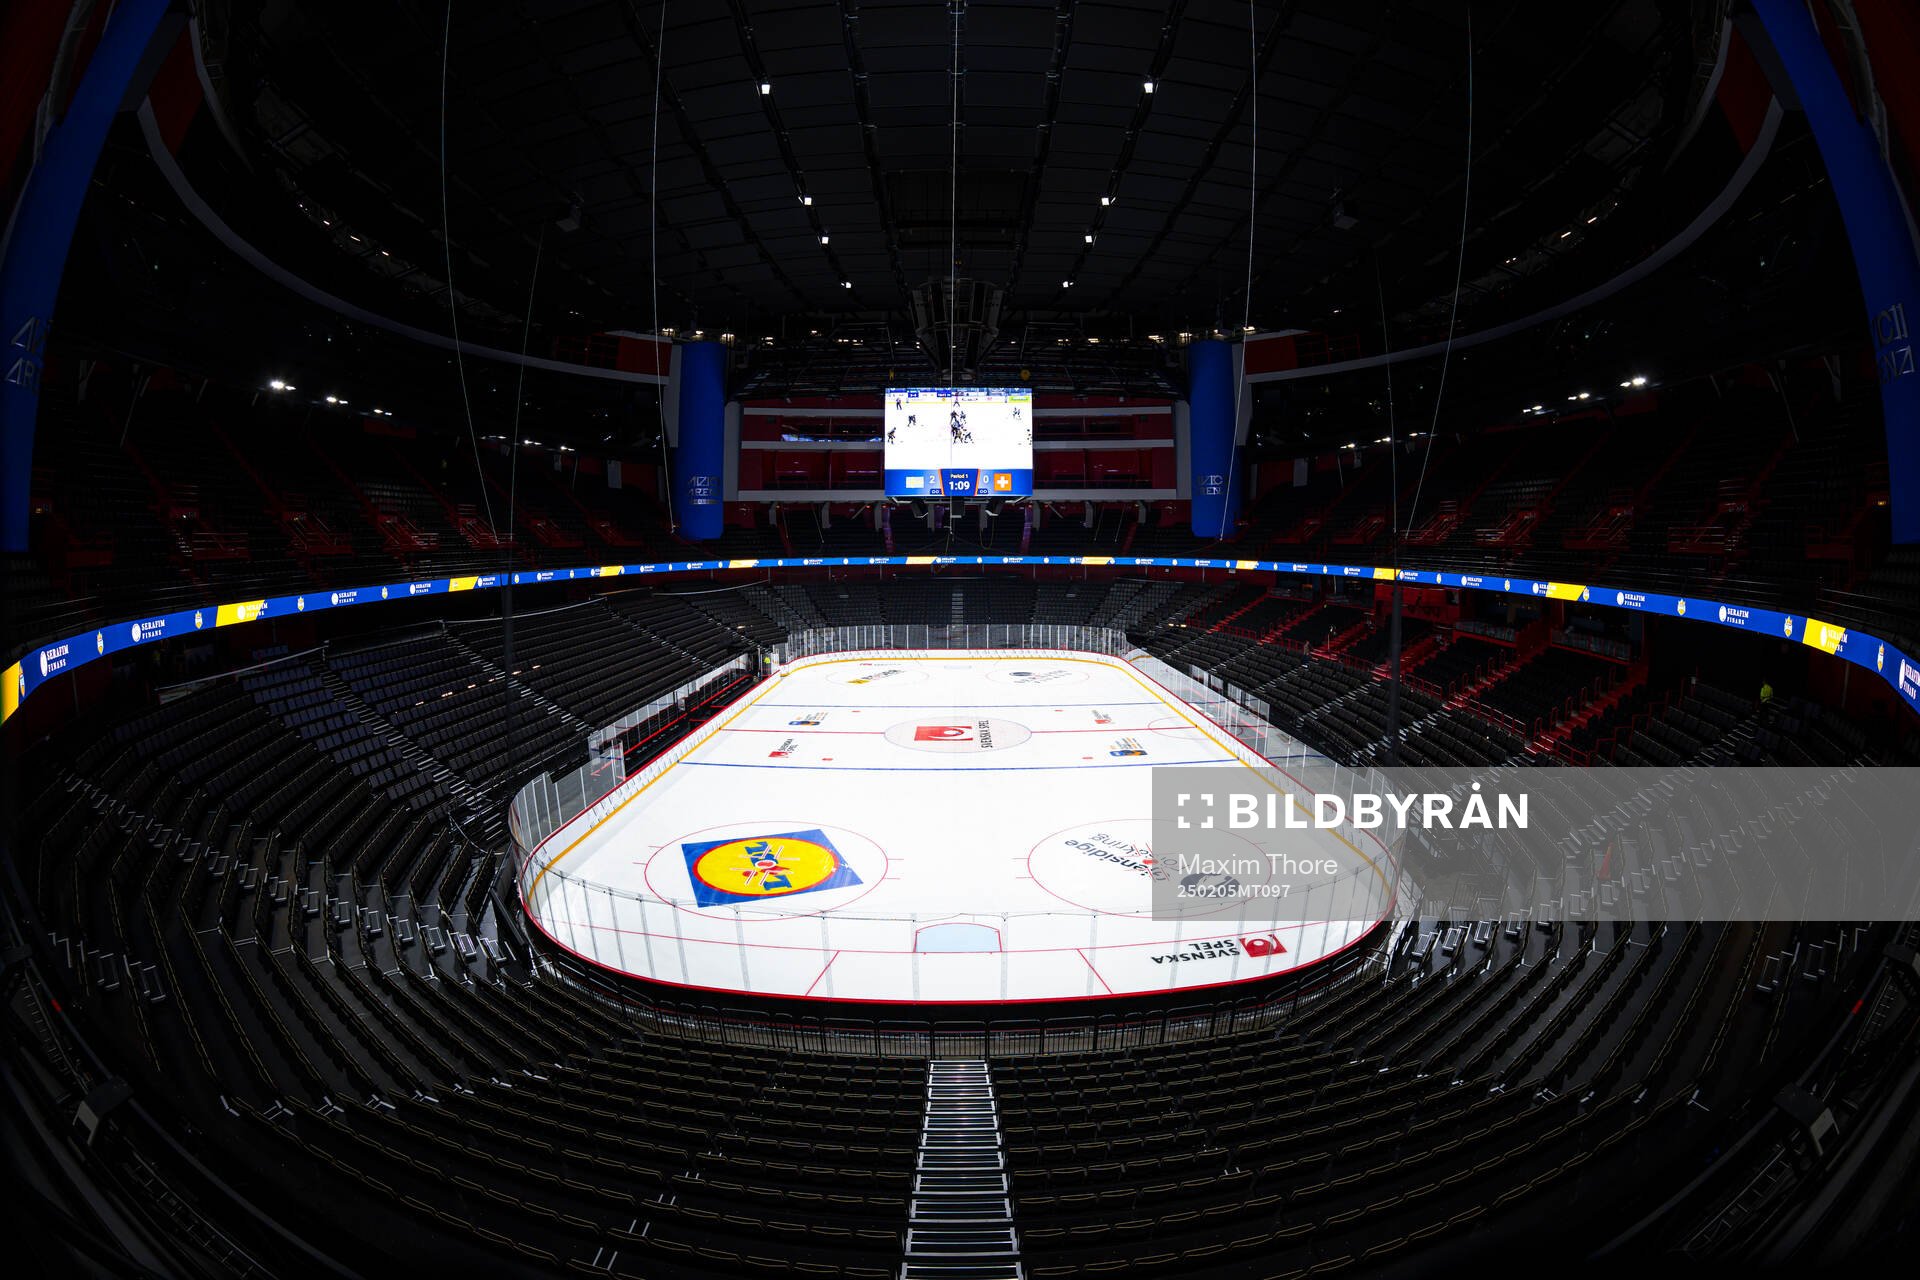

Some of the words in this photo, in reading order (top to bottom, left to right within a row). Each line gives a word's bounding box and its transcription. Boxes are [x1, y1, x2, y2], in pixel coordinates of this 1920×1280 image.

[929, 475, 936, 484] 2
[948, 481, 970, 490] 1:09
[983, 475, 989, 484] 0
[1727, 607, 1749, 619] SERAFIM
[141, 619, 165, 631] SERAFIM
[142, 629, 162, 640] FINANS
[46, 644, 69, 661] SERAFIM
[1188, 939, 1235, 951] SPEL
[1151, 947, 1241, 964] SVENSKA
